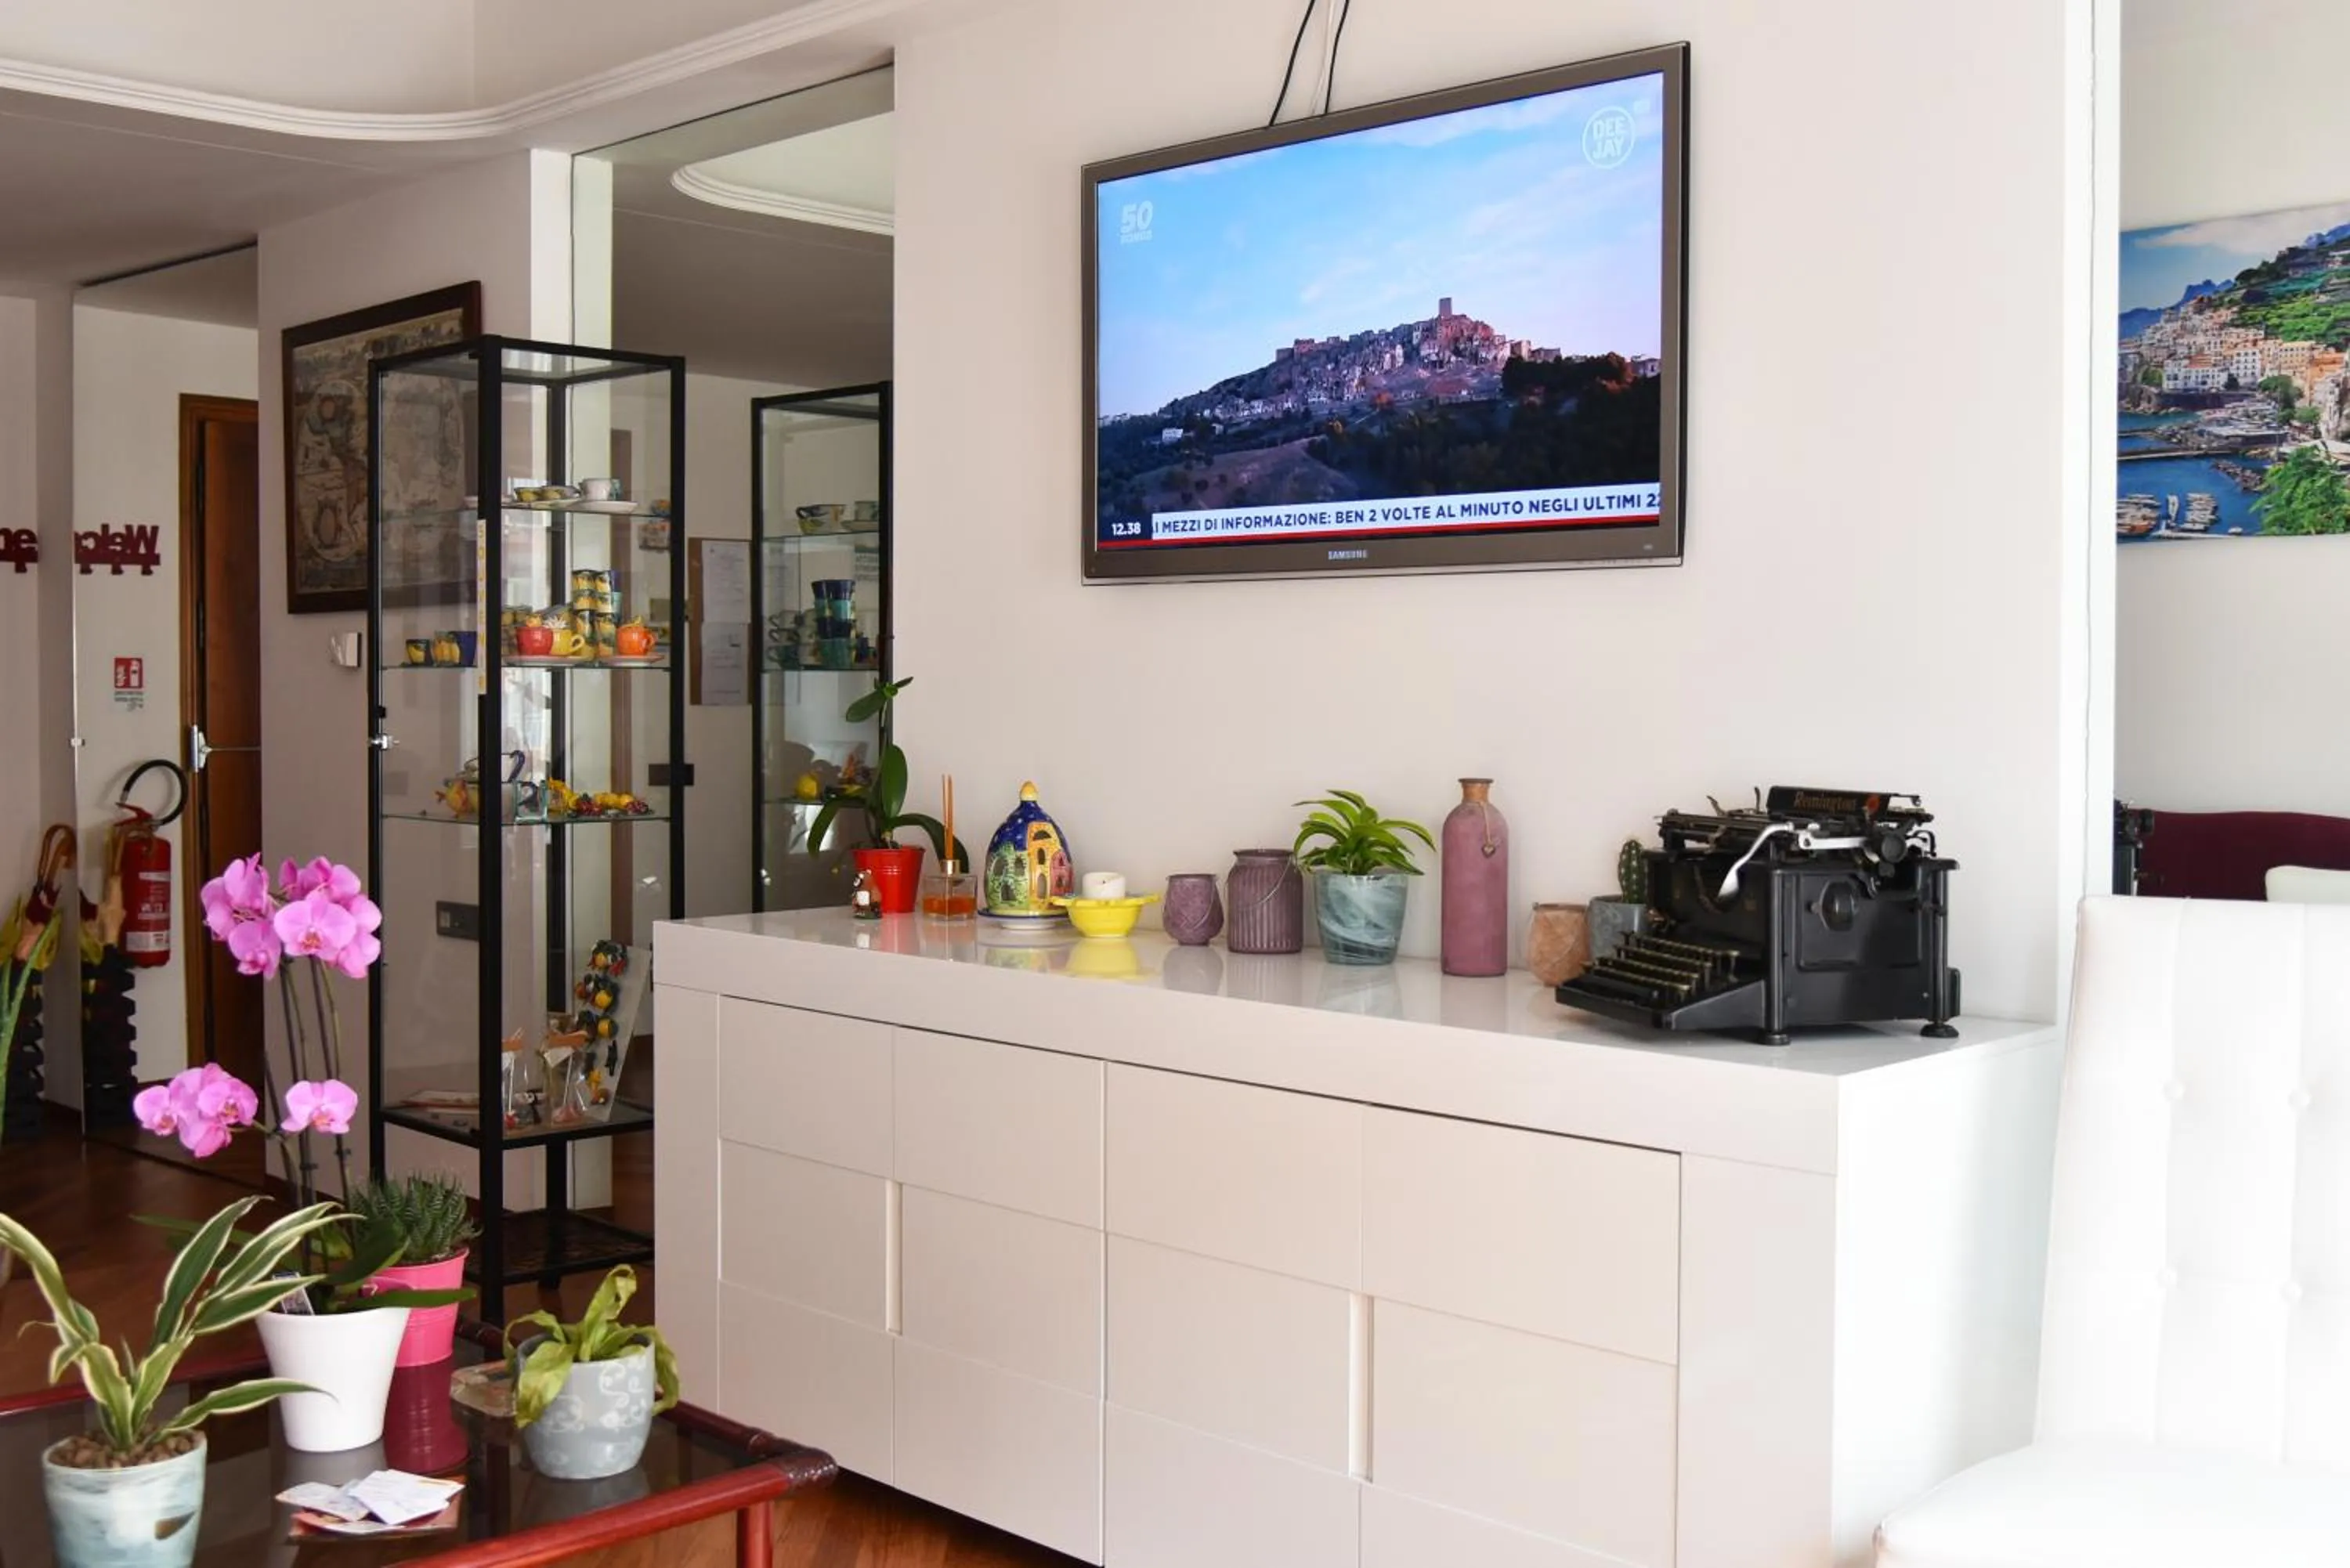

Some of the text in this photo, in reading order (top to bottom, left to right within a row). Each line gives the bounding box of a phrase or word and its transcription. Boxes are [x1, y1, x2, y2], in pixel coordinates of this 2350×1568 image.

[1593, 116, 1627, 139] DEE
[1593, 136, 1625, 159] JAY
[1120, 201, 1153, 233] 50
[1162, 519, 1200, 533] MEZZI
[1204, 518, 1217, 531] DI
[1221, 511, 1331, 529] INFORMAZIONE:
[1336, 509, 1364, 524] BEN
[1369, 509, 1377, 522] 2
[1381, 505, 1431, 521] VOLTE
[1436, 504, 1455, 518] AL
[1460, 501, 1524, 517] MINUTO
[1529, 498, 1578, 513] NEGLI
[1583, 494, 1641, 510] ULTIMI
[1112, 522, 1141, 536] 12.38
[1329, 550, 1367, 560] SAMSUNG
